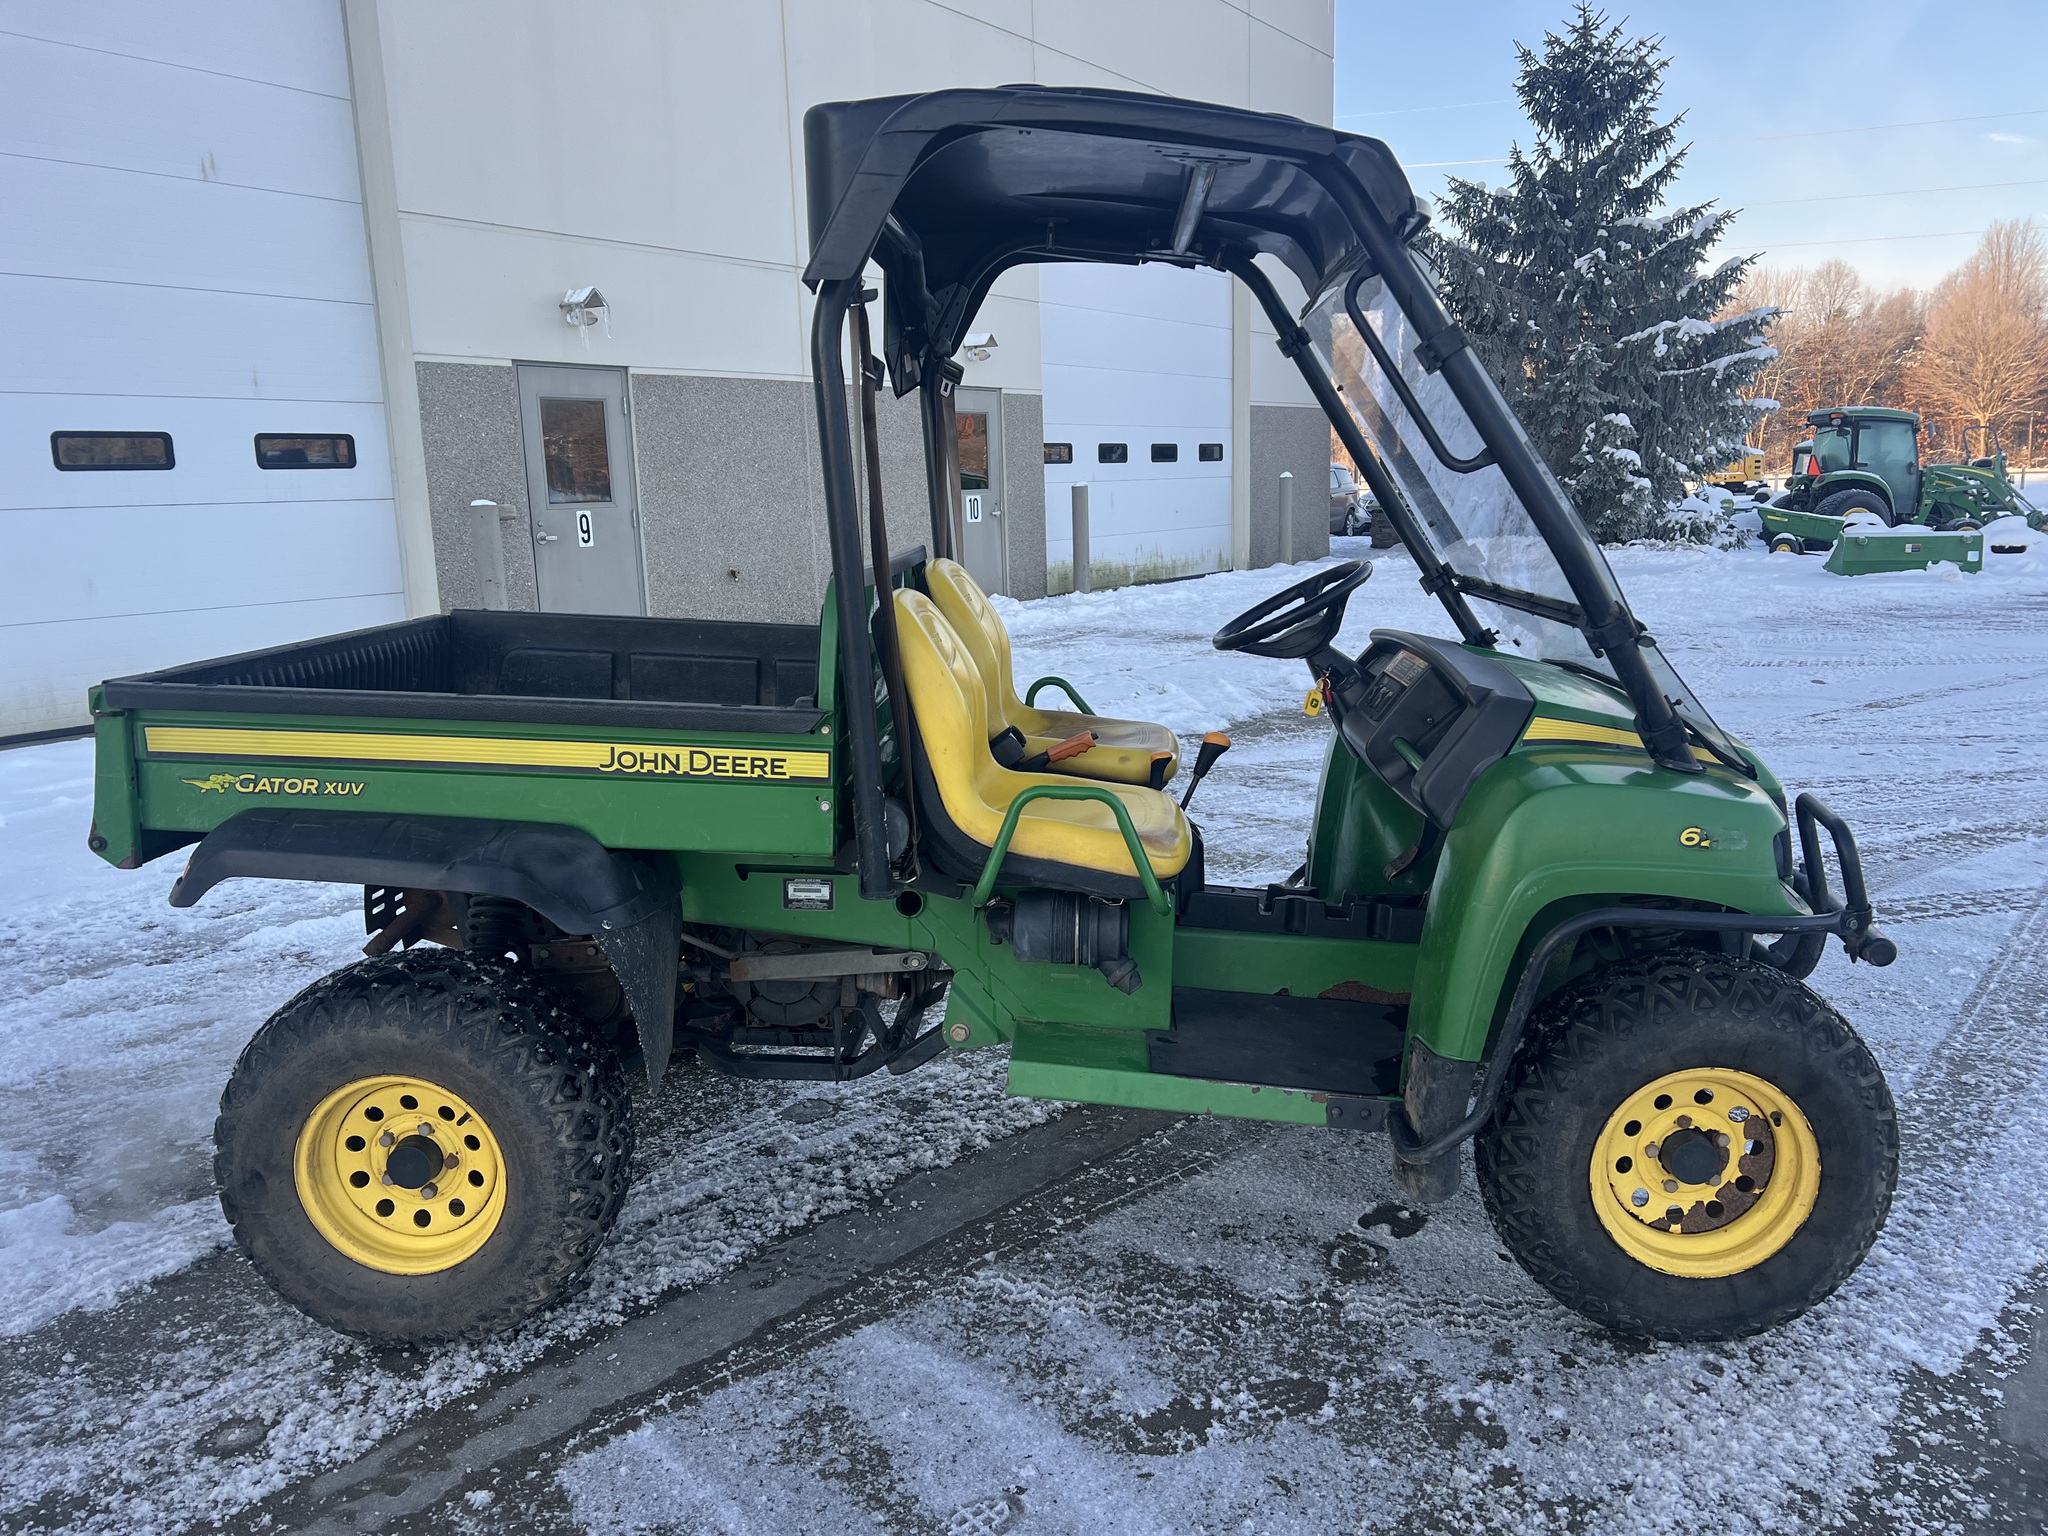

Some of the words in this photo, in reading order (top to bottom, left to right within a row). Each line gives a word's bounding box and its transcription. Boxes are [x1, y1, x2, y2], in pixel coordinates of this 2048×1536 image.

[968, 498, 979, 520] 10
[579, 513, 591, 544] 9
[600, 746, 680, 772] JOHN
[689, 750, 787, 776] DEERE
[234, 773, 319, 795] GATOR
[323, 781, 365, 795] XUV
